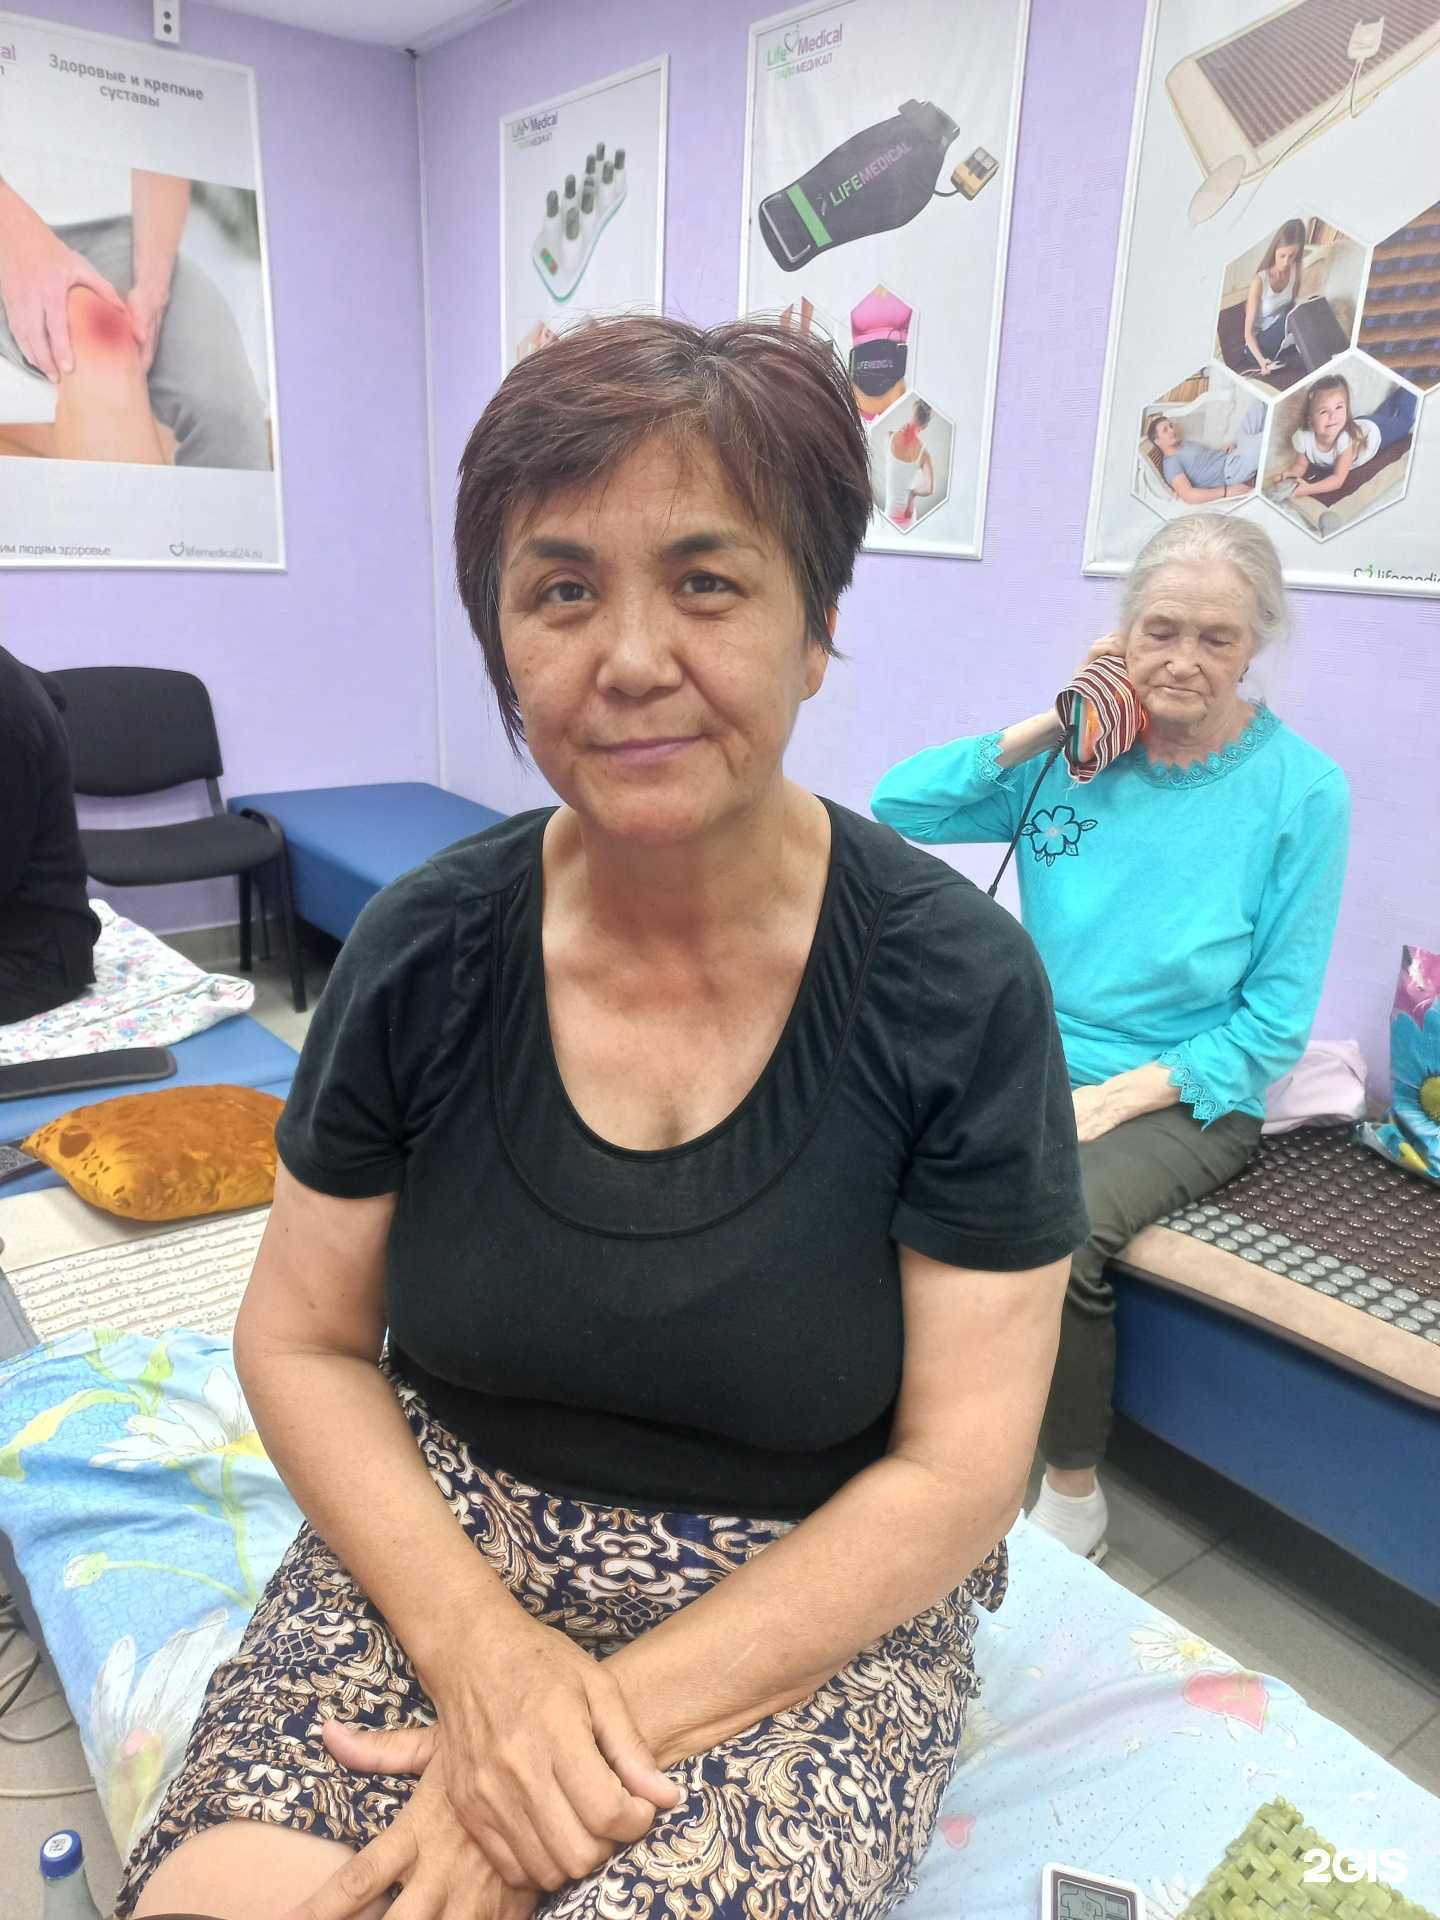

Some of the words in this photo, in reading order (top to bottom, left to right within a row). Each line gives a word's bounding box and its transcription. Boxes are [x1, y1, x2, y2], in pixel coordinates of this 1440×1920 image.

[797, 23, 843, 57] Medical
[49, 53, 126, 83] Здоровые
[130, 75, 140, 86] и
[144, 76, 204, 101] крепкие
[99, 84, 160, 108] суставы
